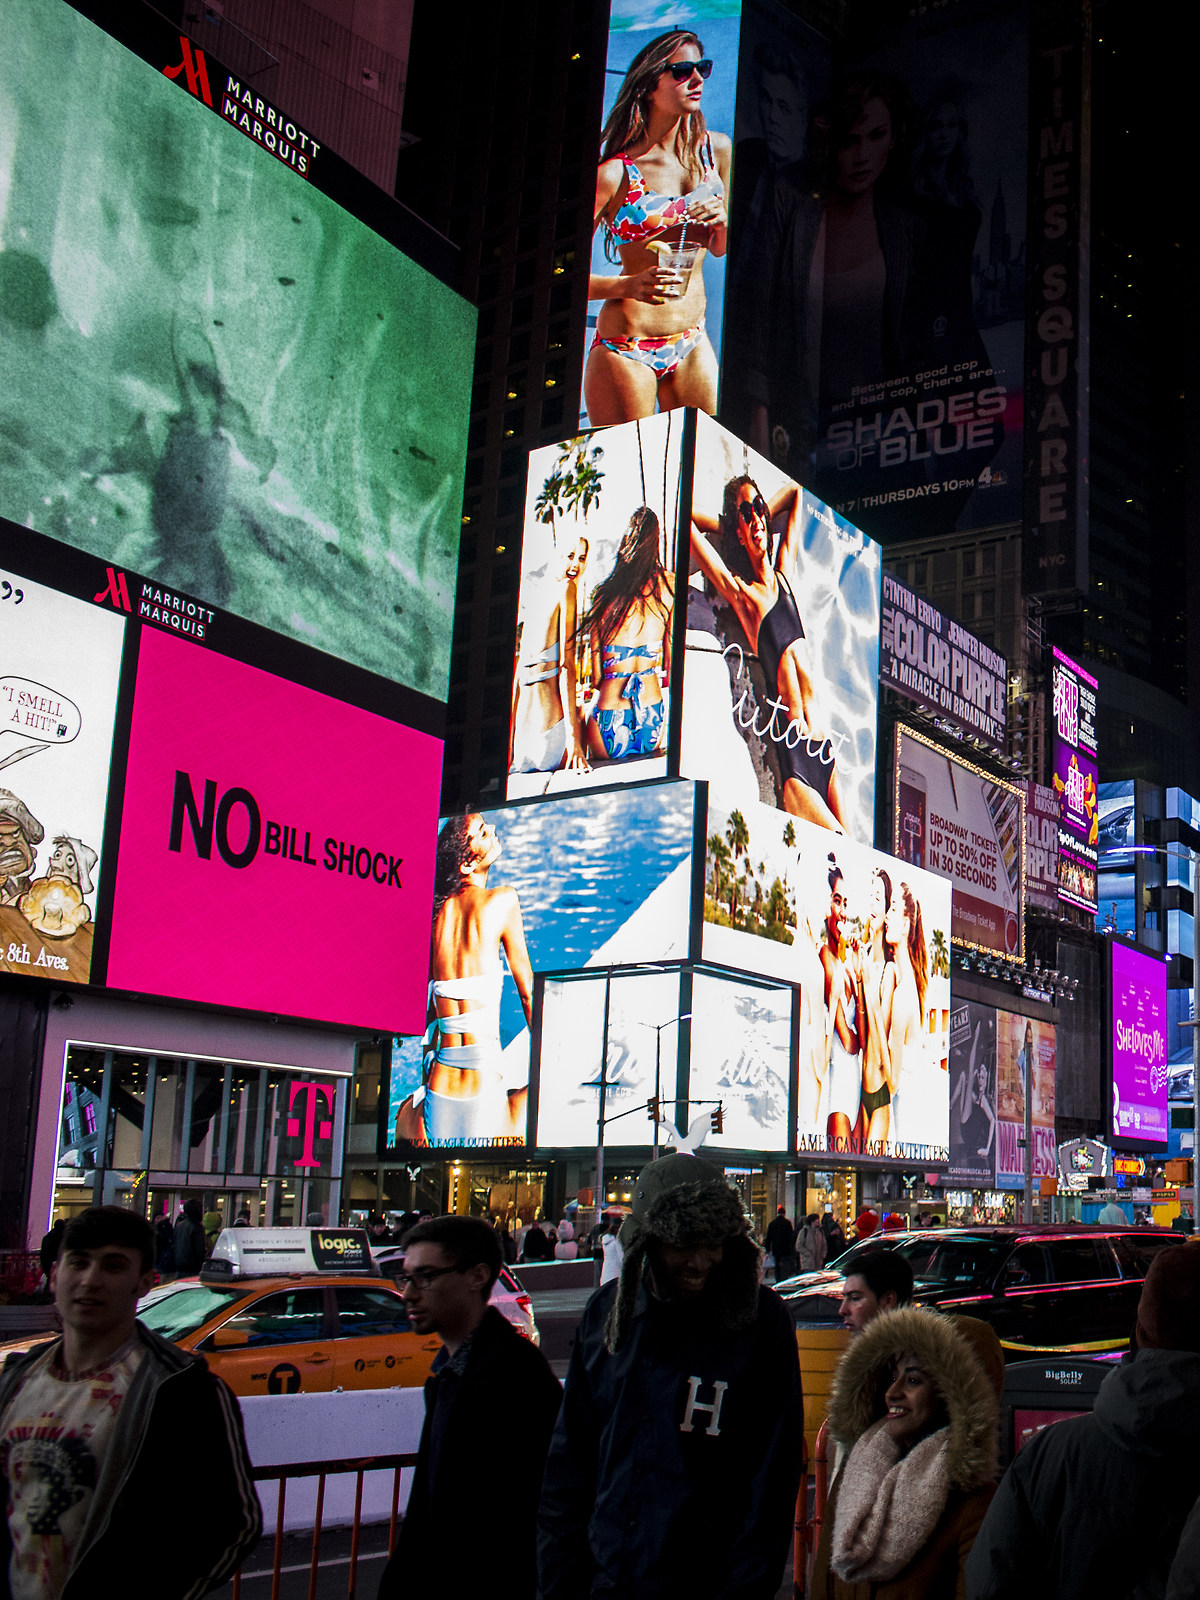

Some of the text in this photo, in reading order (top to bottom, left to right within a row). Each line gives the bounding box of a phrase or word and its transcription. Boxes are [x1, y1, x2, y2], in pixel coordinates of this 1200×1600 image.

[224, 99, 307, 173] MARQUIS
[227, 76, 320, 158] MARRIOTT
[1038, 43, 1075, 240] TIMES
[831, 399, 855, 412] and
[859, 392, 885, 405] bad
[923, 375, 963, 390] there
[850, 360, 979, 398] Between good cop
[1036, 263, 1075, 524] SQUARE
[826, 385, 1008, 450] SHADES
[835, 417, 995, 471] OF BLUE
[862, 482, 941, 508] THURSDAYS
[1037, 553, 1066, 569] NYC
[140, 602, 204, 638] MARQUIS
[142, 584, 215, 623] MARRIOTT
[882, 575, 917, 618] CYNTHIA
[917, 597, 942, 634] ERIVO
[948, 620, 980, 659] JENNIFER
[979, 641, 1007, 680] HUDSON
[882, 606, 895, 655] THE
[894, 610, 951, 689] COLOR
[951, 647, 1007, 725] PURPLE
[899, 664, 940, 704] MIRACLE
[940, 688, 953, 712] ON
[10, 708, 21, 723] A
[17, 691, 63, 718] SMELL
[1034, 795, 1059, 818] HUDSON
[167, 769, 404, 889] NO BILL SHOCK
[929, 813, 998, 854] BROADWAY TICKETS
[1026, 813, 1059, 853] OLOR
[929, 829, 998, 873] UP TO 50% OFF
[929, 849, 998, 892] IN 30 SECONDS
[1025, 845, 1059, 885] RPLE
[959, 907, 977, 926] Broadway
[977, 913, 988, 927] Ticket
[988, 919, 997, 933] App
[6, 942, 70, 971] 8th Aves.
[287, 1080, 334, 1168] T
[799, 1132, 860, 1155] AMERICAN
[861, 1137, 892, 1157] EAGLE
[998, 1122, 1056, 1177] WAITESS
[317, 1233, 361, 1255] logic.
[1044, 1370, 1084, 1381] BigBelly
[679, 1375, 729, 1437] H
